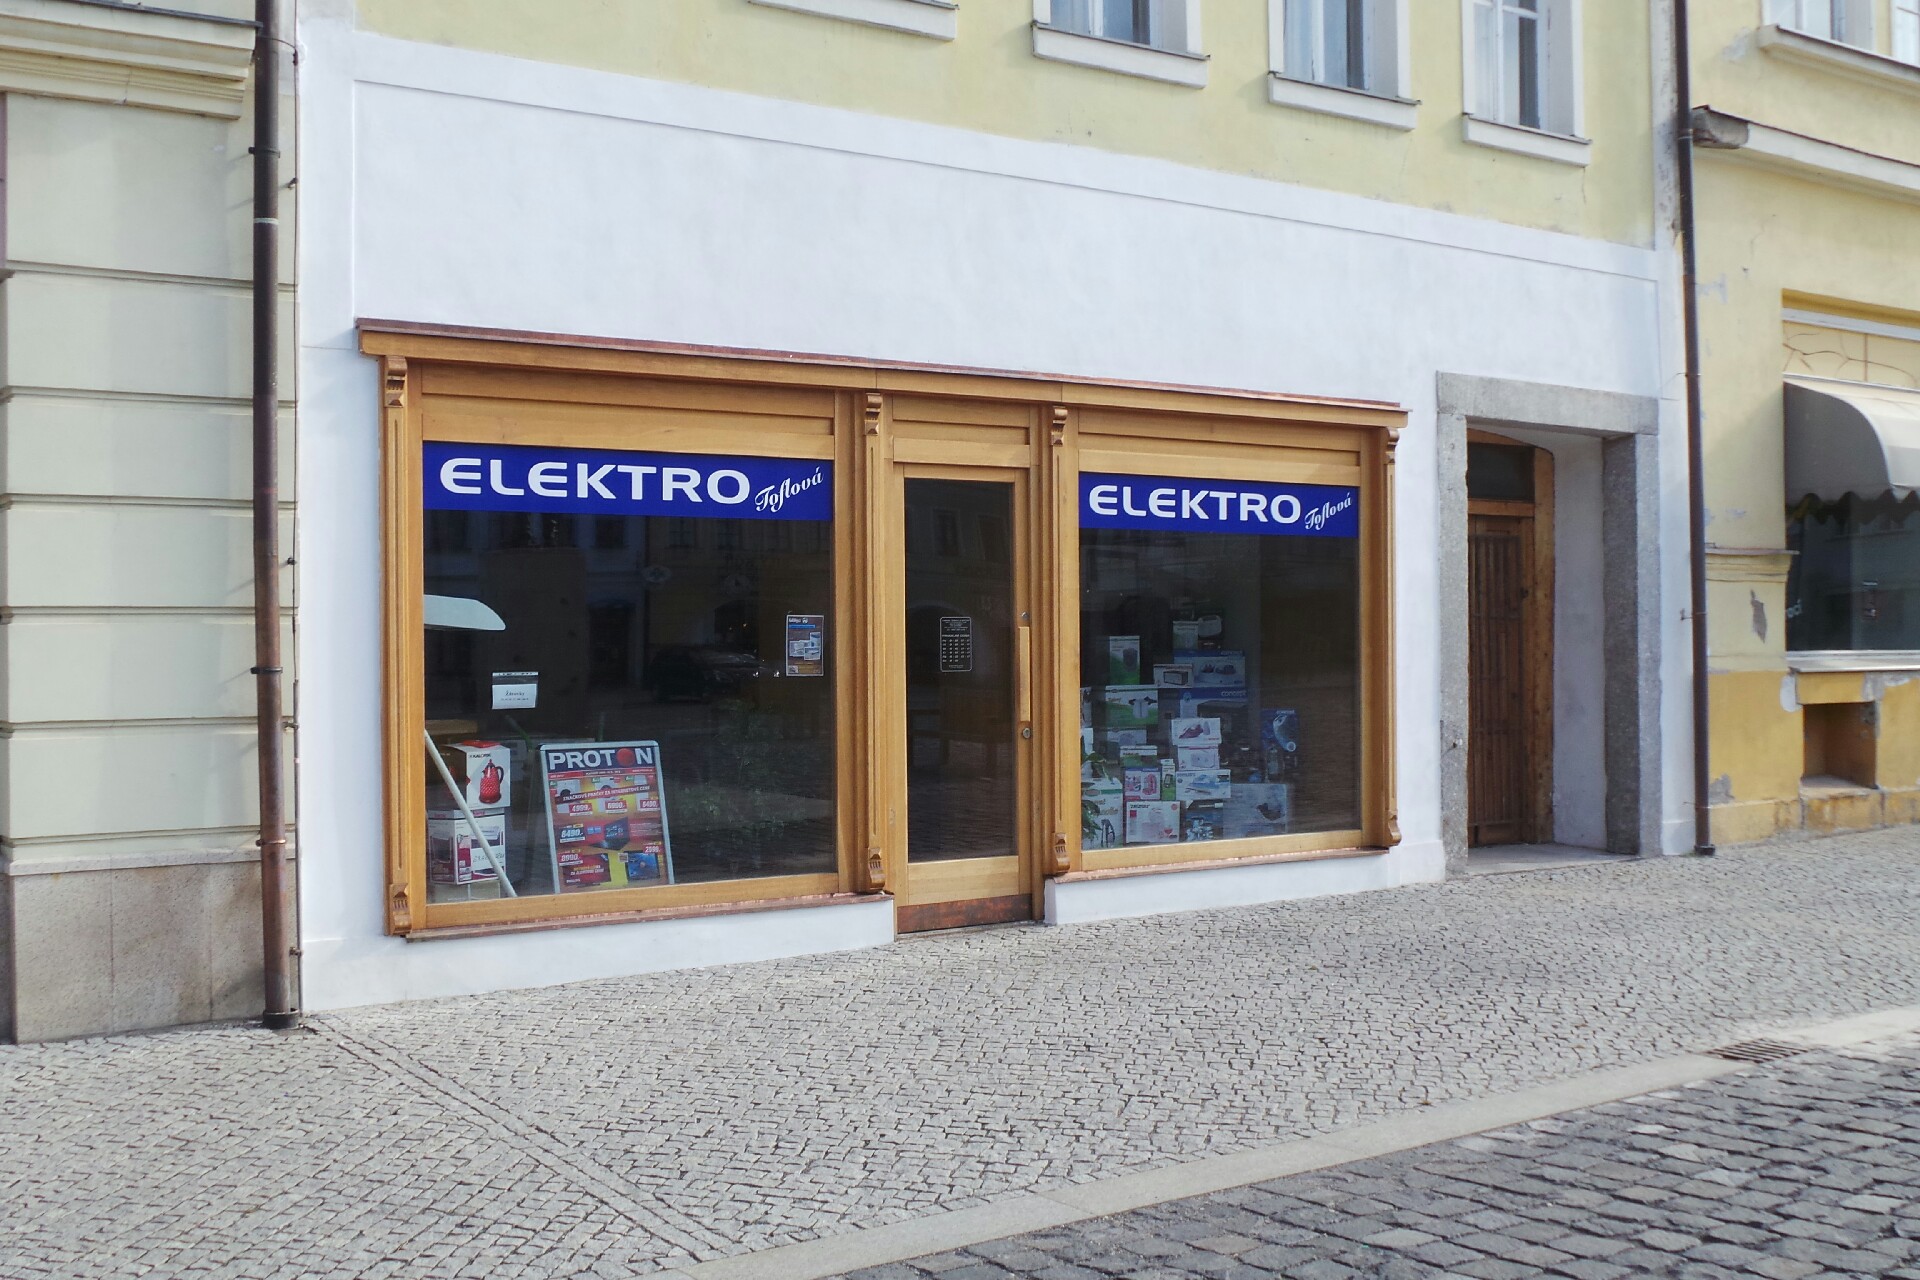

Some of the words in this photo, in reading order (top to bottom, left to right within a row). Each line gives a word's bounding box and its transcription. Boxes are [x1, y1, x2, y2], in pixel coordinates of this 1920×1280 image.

[439, 457, 751, 505] ELEKTRO
[754, 466, 825, 513] Toflová
[1088, 484, 1301, 525] ELEKTRO
[1304, 491, 1353, 531] Toflová
